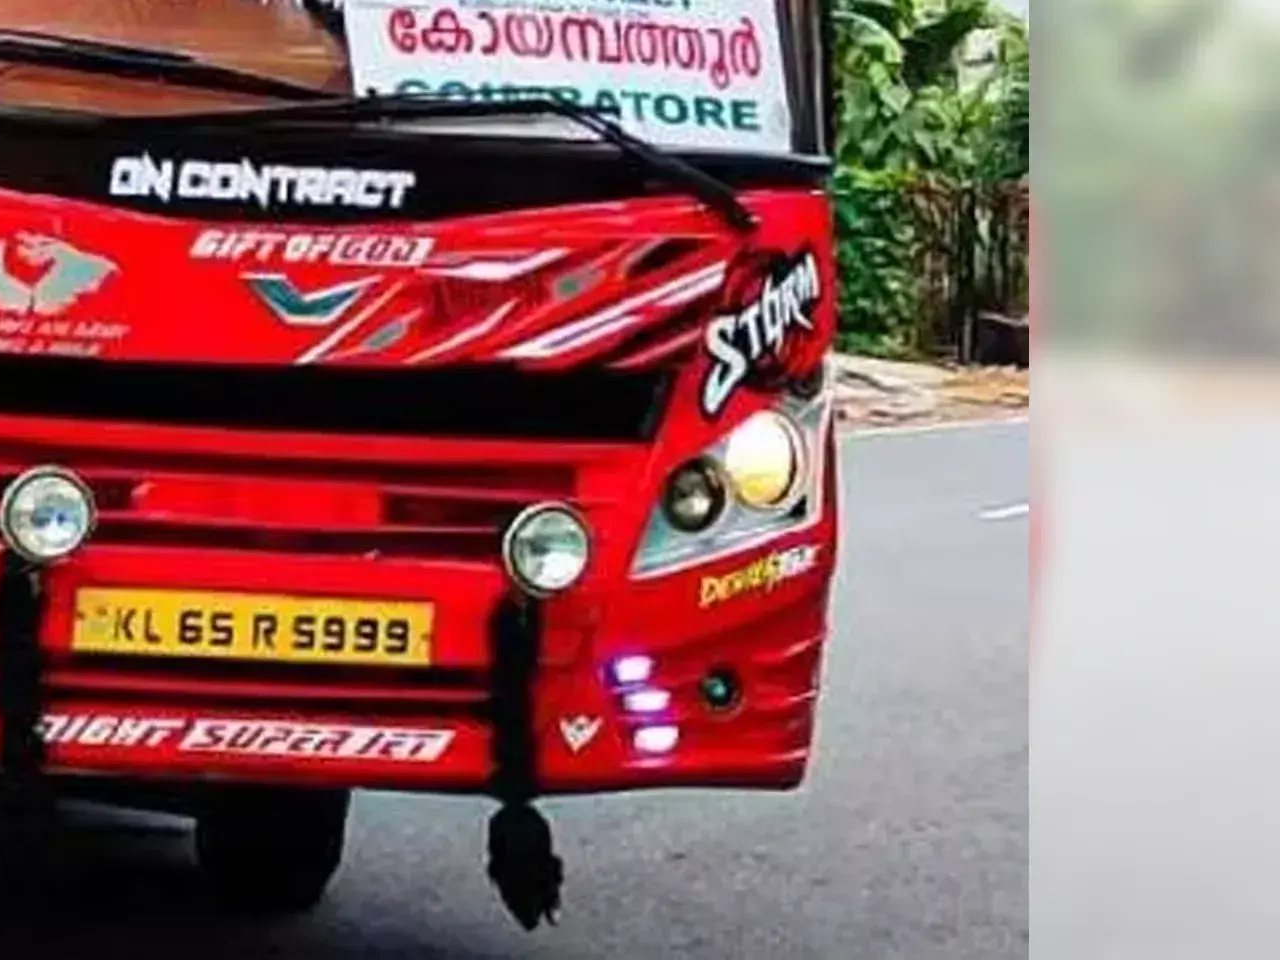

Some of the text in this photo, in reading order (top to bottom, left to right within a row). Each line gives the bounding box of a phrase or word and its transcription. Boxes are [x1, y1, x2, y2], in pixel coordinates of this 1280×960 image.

[109, 151, 417, 210] ON CONTRACT
[189, 228, 288, 260] GIFT
[283, 233, 334, 263] OF
[114, 607, 411, 654] KL 65 R 5999
[186, 722, 352, 755] SUPER
